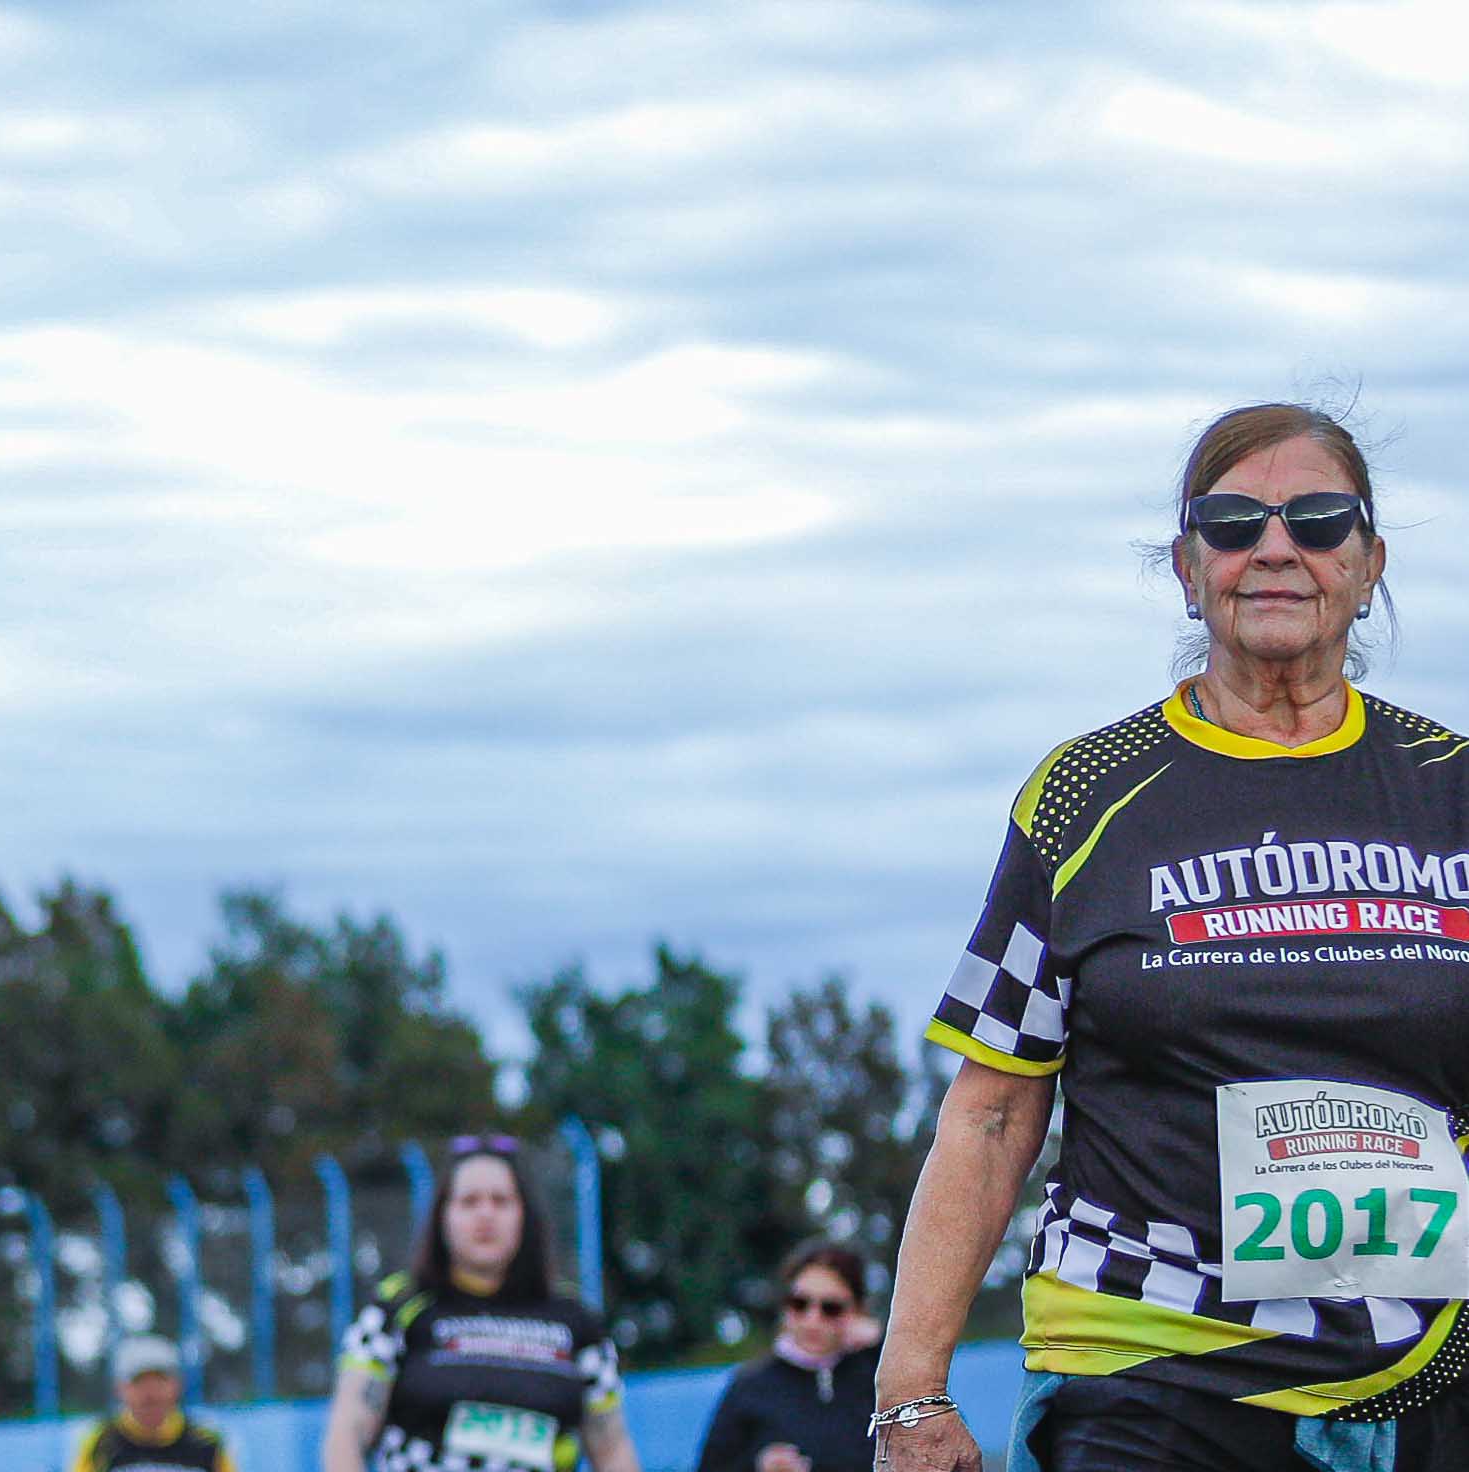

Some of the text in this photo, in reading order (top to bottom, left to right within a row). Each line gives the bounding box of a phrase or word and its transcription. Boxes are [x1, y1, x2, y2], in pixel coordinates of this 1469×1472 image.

[1149, 831, 1469, 913] AUTÓDROMO
[1202, 902, 1442, 938] RUNNING RACE
[1141, 952, 1163, 970] La
[1168, 949, 1245, 966] Carrera
[1249, 948, 1276, 964] de
[1280, 947, 1311, 963] los
[1314, 946, 1386, 962] Clubes
[1390, 944, 1423, 960] del
[1255, 1091, 1428, 1140] AUTÓDROMO
[1284, 1133, 1404, 1157] RUNNING RACE
[1255, 1165, 1266, 1175] La
[1268, 1163, 1306, 1173] Carrera
[1307, 1161, 1320, 1171] de
[1322, 1160, 1337, 1170] los
[1339, 1160, 1373, 1170] Clubes
[1375, 1160, 1390, 1169] del
[1233, 1187, 1458, 1261] 2017
